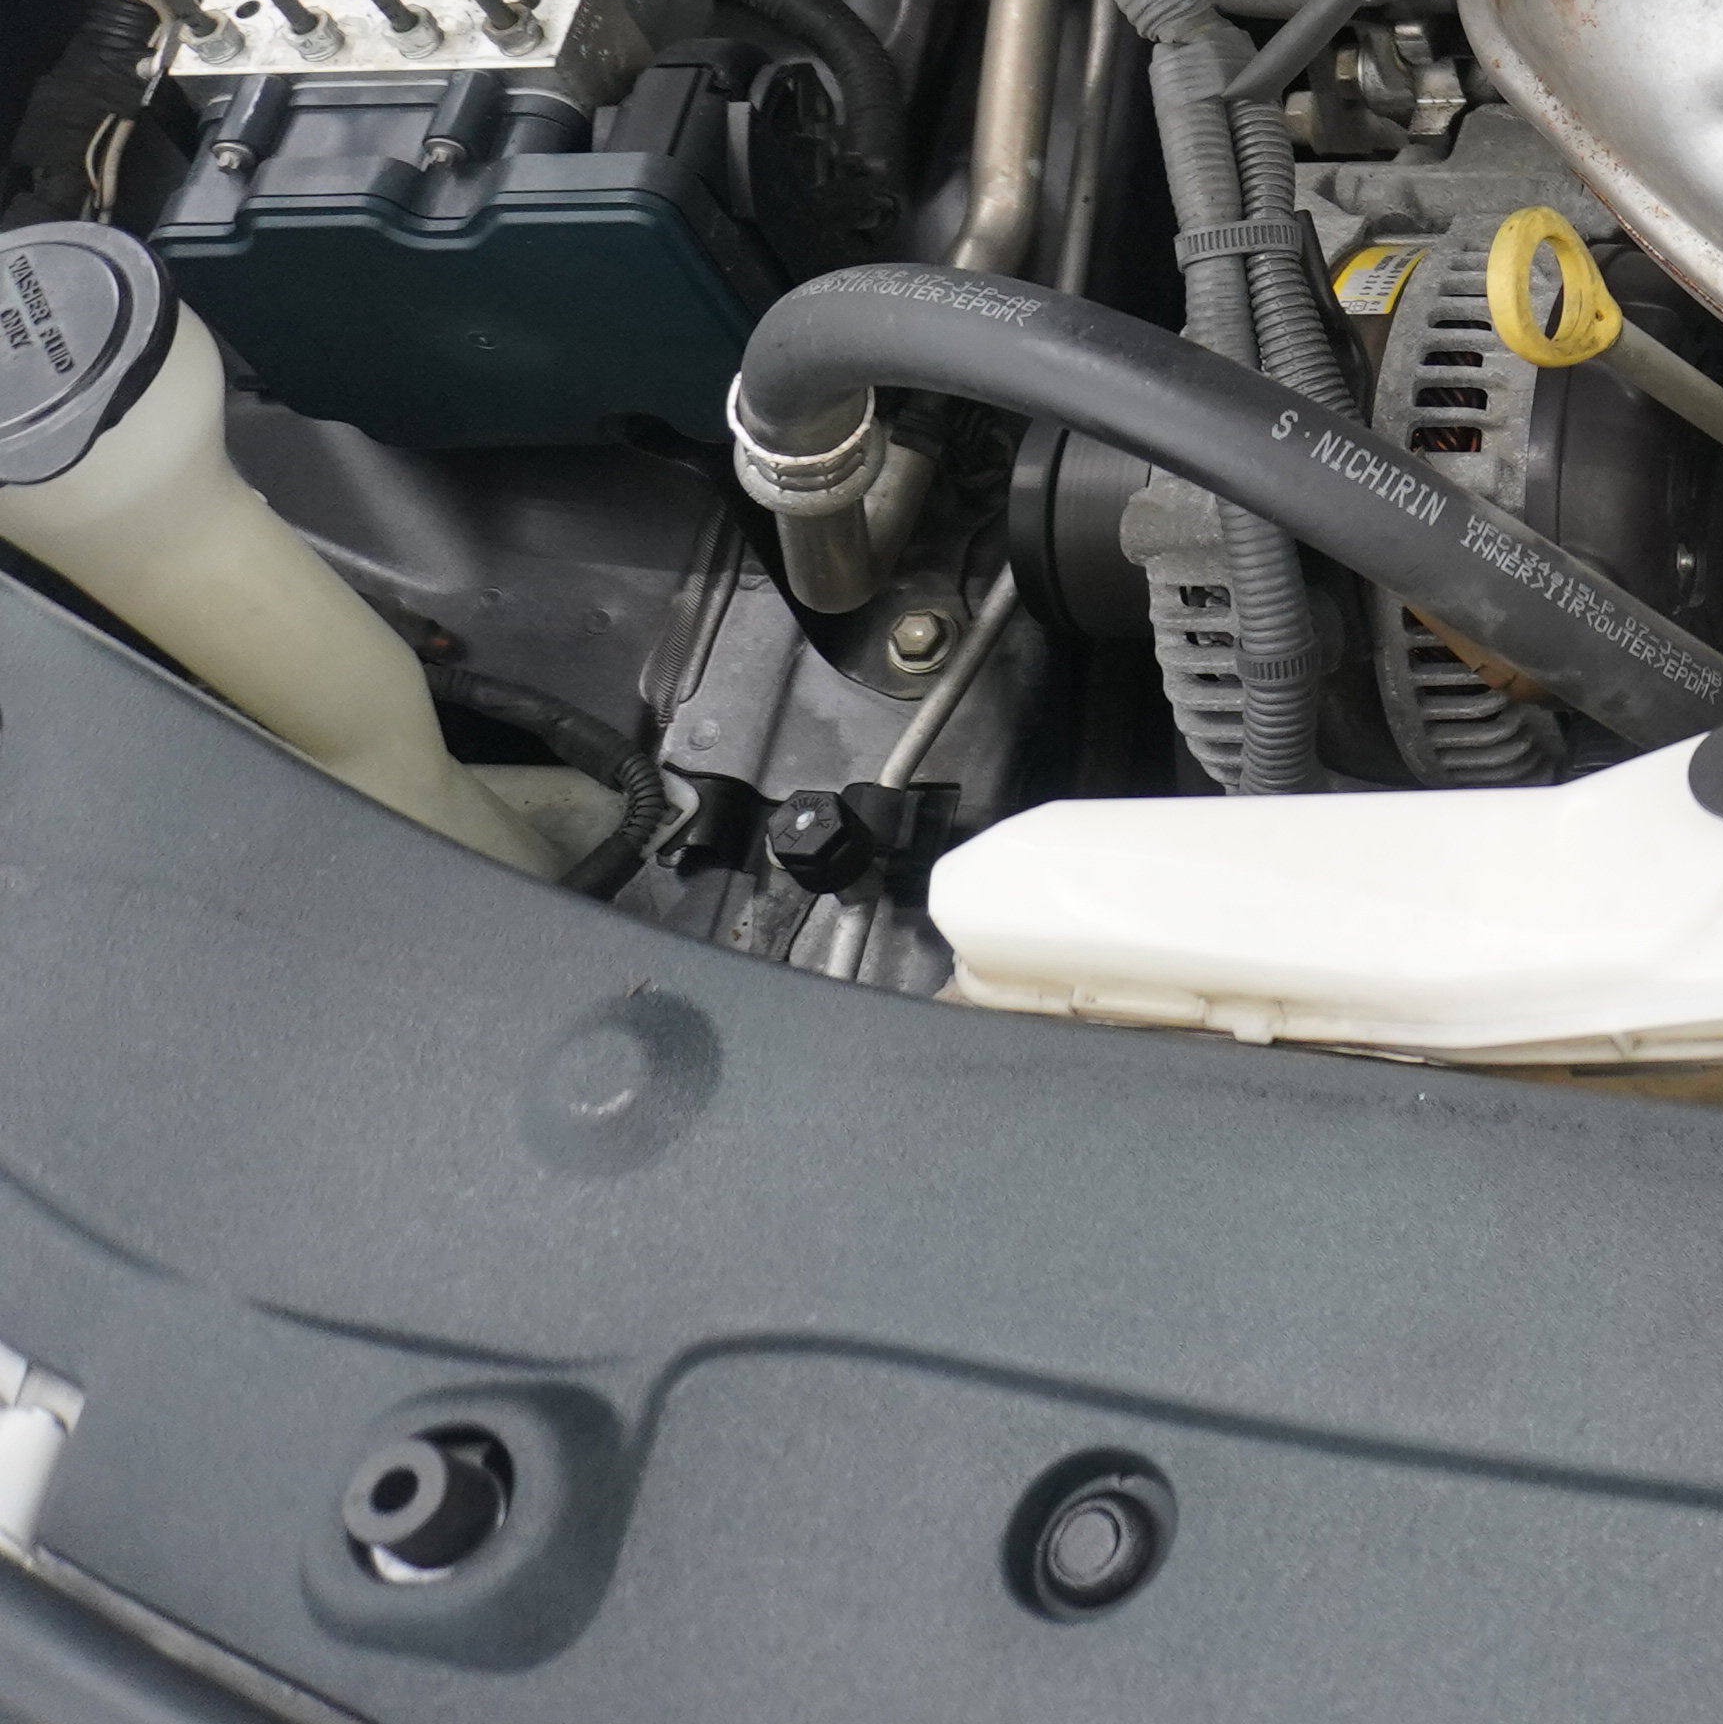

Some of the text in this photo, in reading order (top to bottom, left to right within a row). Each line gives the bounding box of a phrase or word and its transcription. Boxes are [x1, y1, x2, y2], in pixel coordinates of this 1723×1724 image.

[0, 307, 33, 350] ONLY
[8, 254, 75, 375] WASHER FLUID
